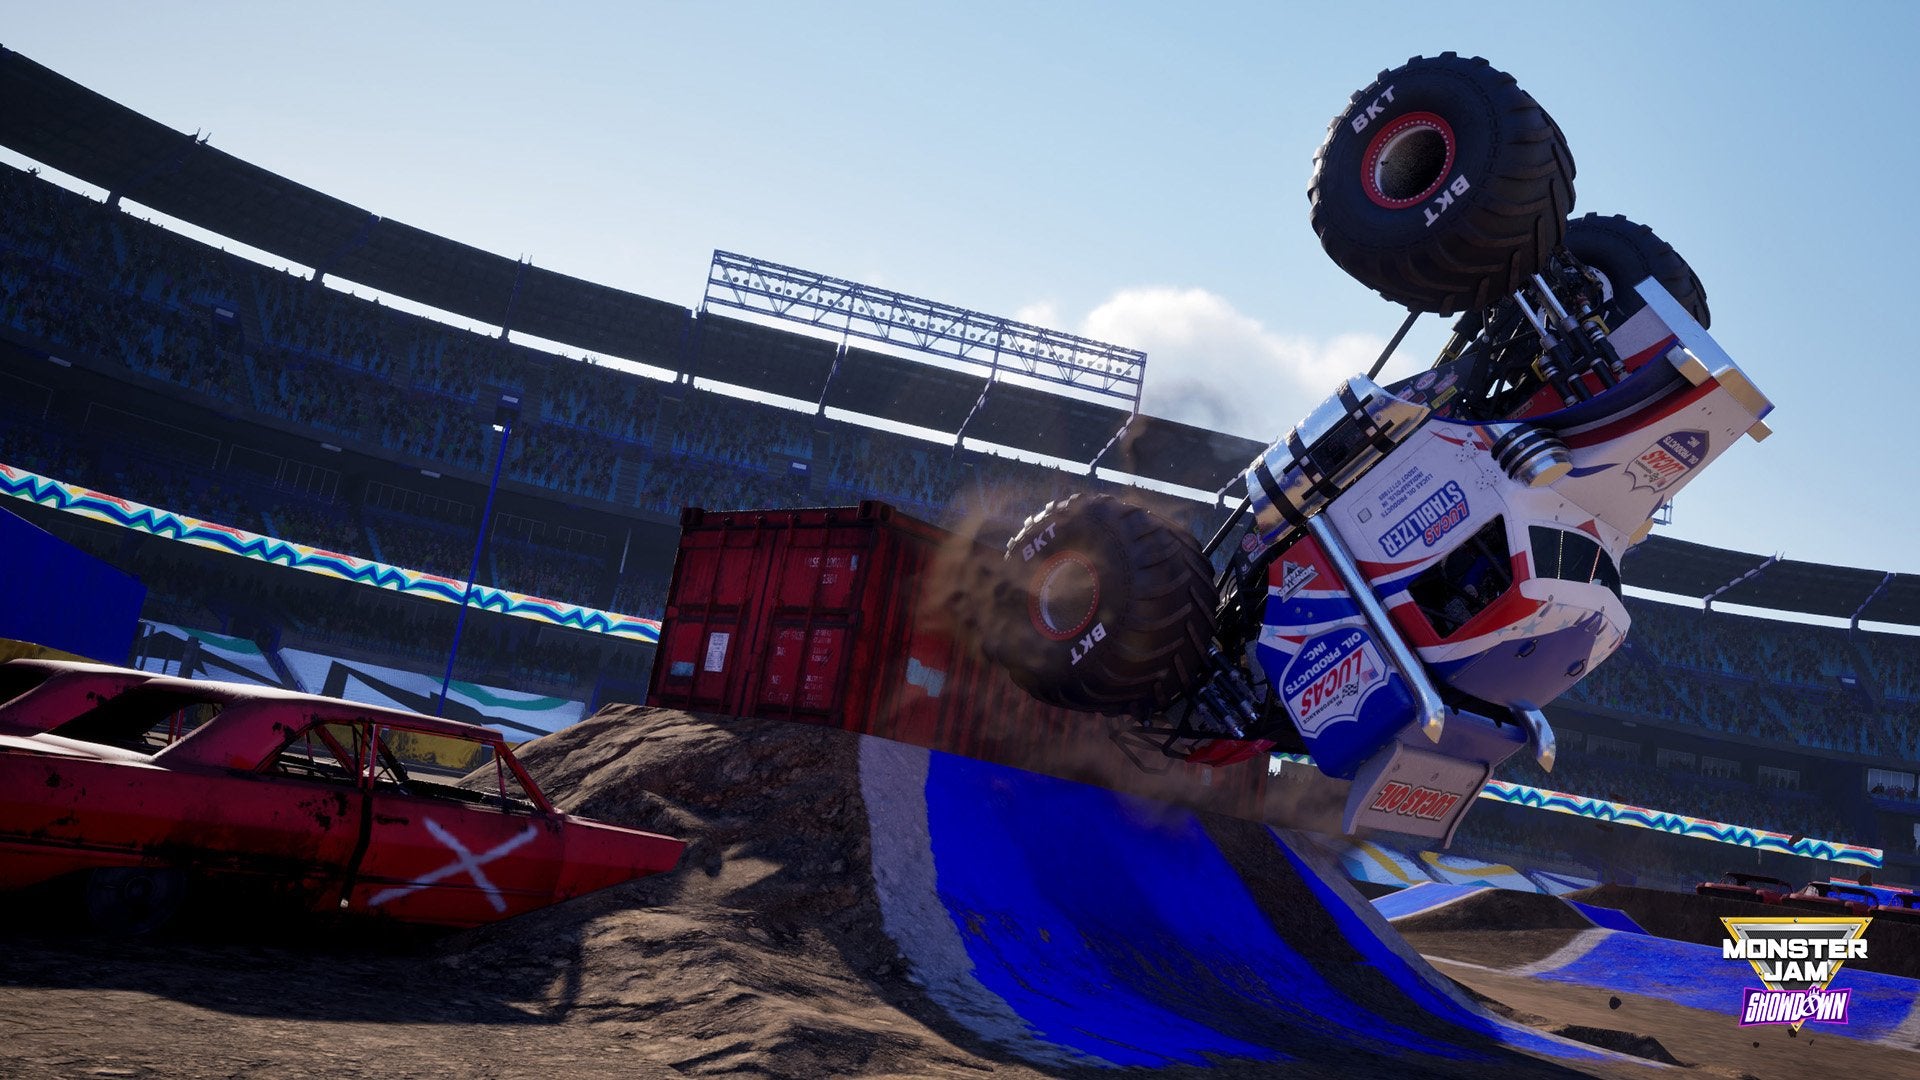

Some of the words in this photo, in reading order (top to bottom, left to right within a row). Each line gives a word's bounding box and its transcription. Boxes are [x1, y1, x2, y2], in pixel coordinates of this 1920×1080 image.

[1351, 85, 1395, 134] BKT
[1423, 174, 1470, 227] BKT
[1642, 450, 1685, 477] LUCAS
[1407, 487, 1416, 496] OIL
[1416, 473, 1434, 489] LUCAS
[1380, 494, 1408, 518] PRODUCTS
[1380, 481, 1463, 556] STABILIZER
[1424, 502, 1468, 546] LUCAS
[1022, 522, 1056, 561] BKT
[1277, 564, 1316, 597] MONSTER
[1070, 622, 1107, 665] BKT
[1303, 641, 1327, 661] INC.
[1341, 632, 1360, 648] OIL
[1286, 647, 1341, 694] PRODUCTS
[1300, 648, 1362, 716] LUCAS
[1302, 694, 1340, 724] PERFORMANCE
[1370, 780, 1412, 813] OIL
[1397, 786, 1460, 822] LUCAS
